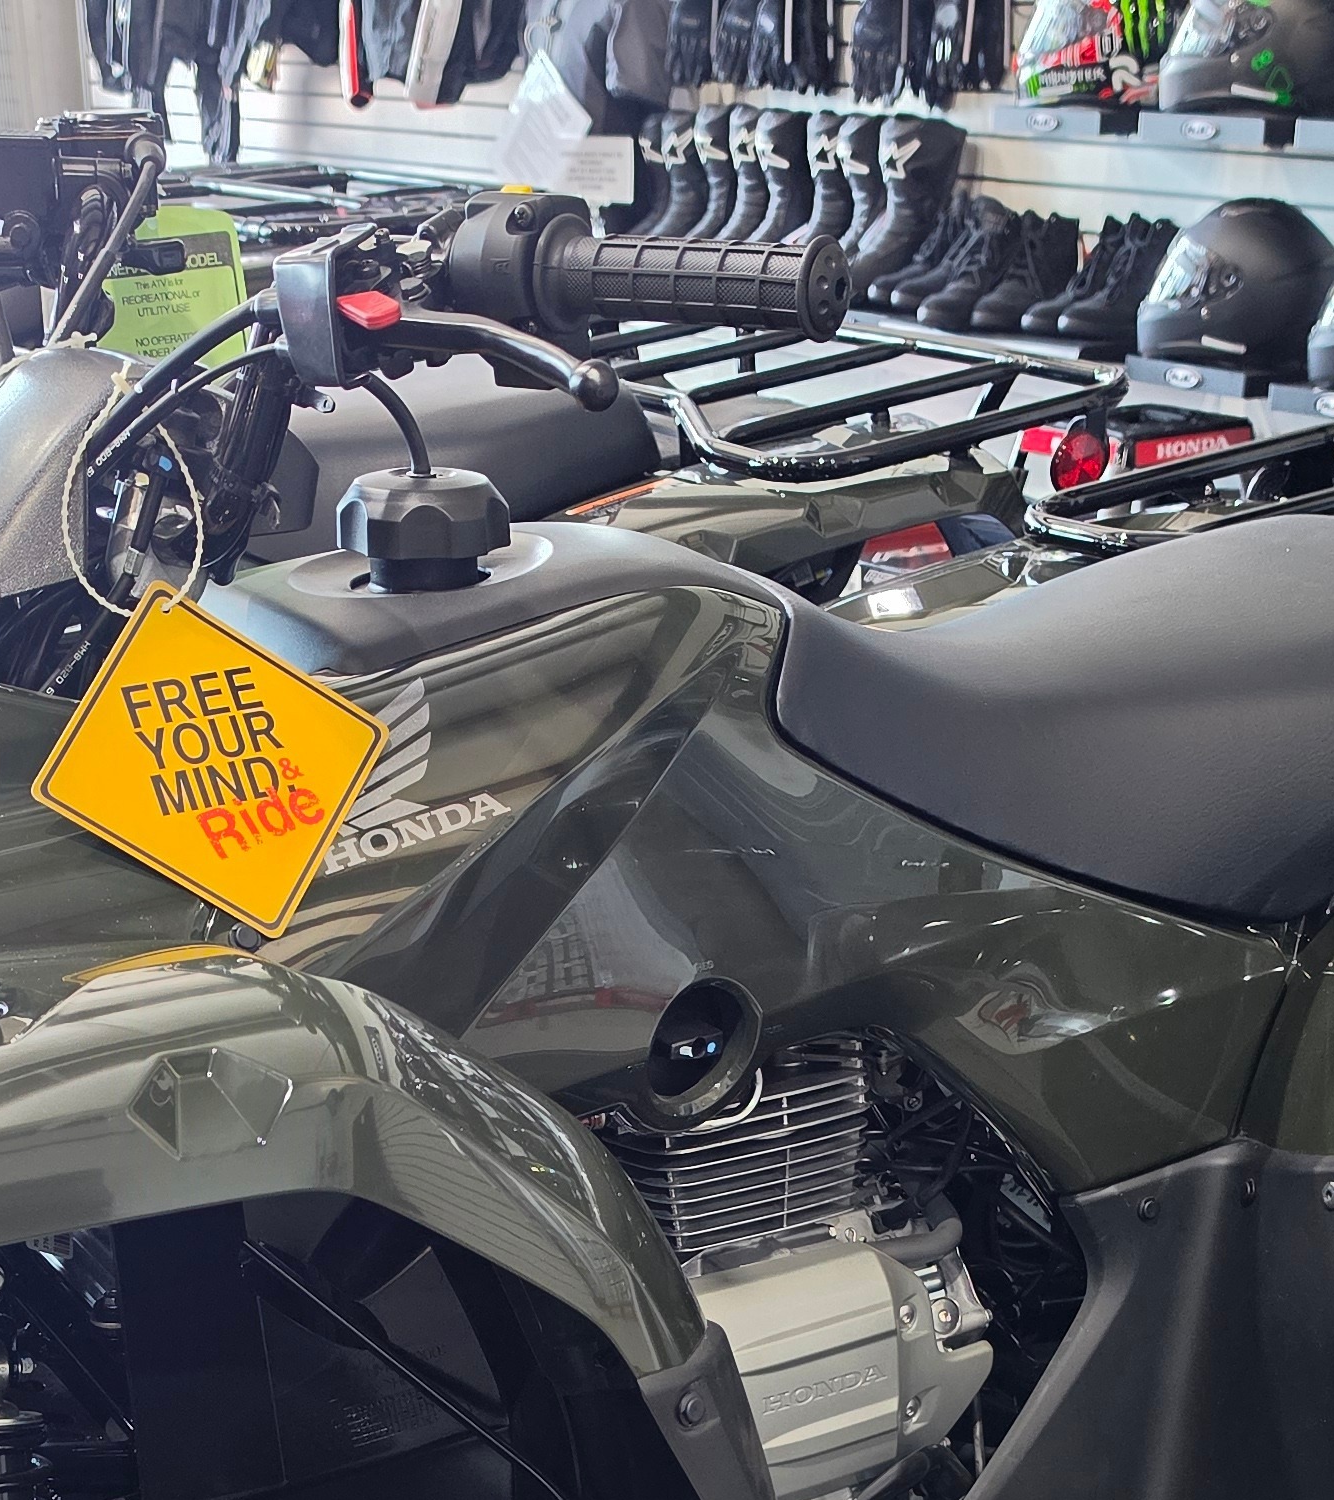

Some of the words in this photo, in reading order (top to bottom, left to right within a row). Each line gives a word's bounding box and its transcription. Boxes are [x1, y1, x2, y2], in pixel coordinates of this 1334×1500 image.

[151, 277, 167, 289] ATV
[122, 291, 192, 306] RECREATIONAL
[137, 306, 172, 318] UTILITY
[172, 302, 192, 315] USE
[135, 338, 150, 348] NO
[1156, 434, 1230, 460] HONDA
[120, 666, 264, 729] FREE
[133, 710, 284, 770] YOUR
[278, 757, 304, 781] &
[196, 785, 326, 860] Ride
[323, 791, 511, 877] HONDA
[762, 1364, 888, 1416] HONDA
